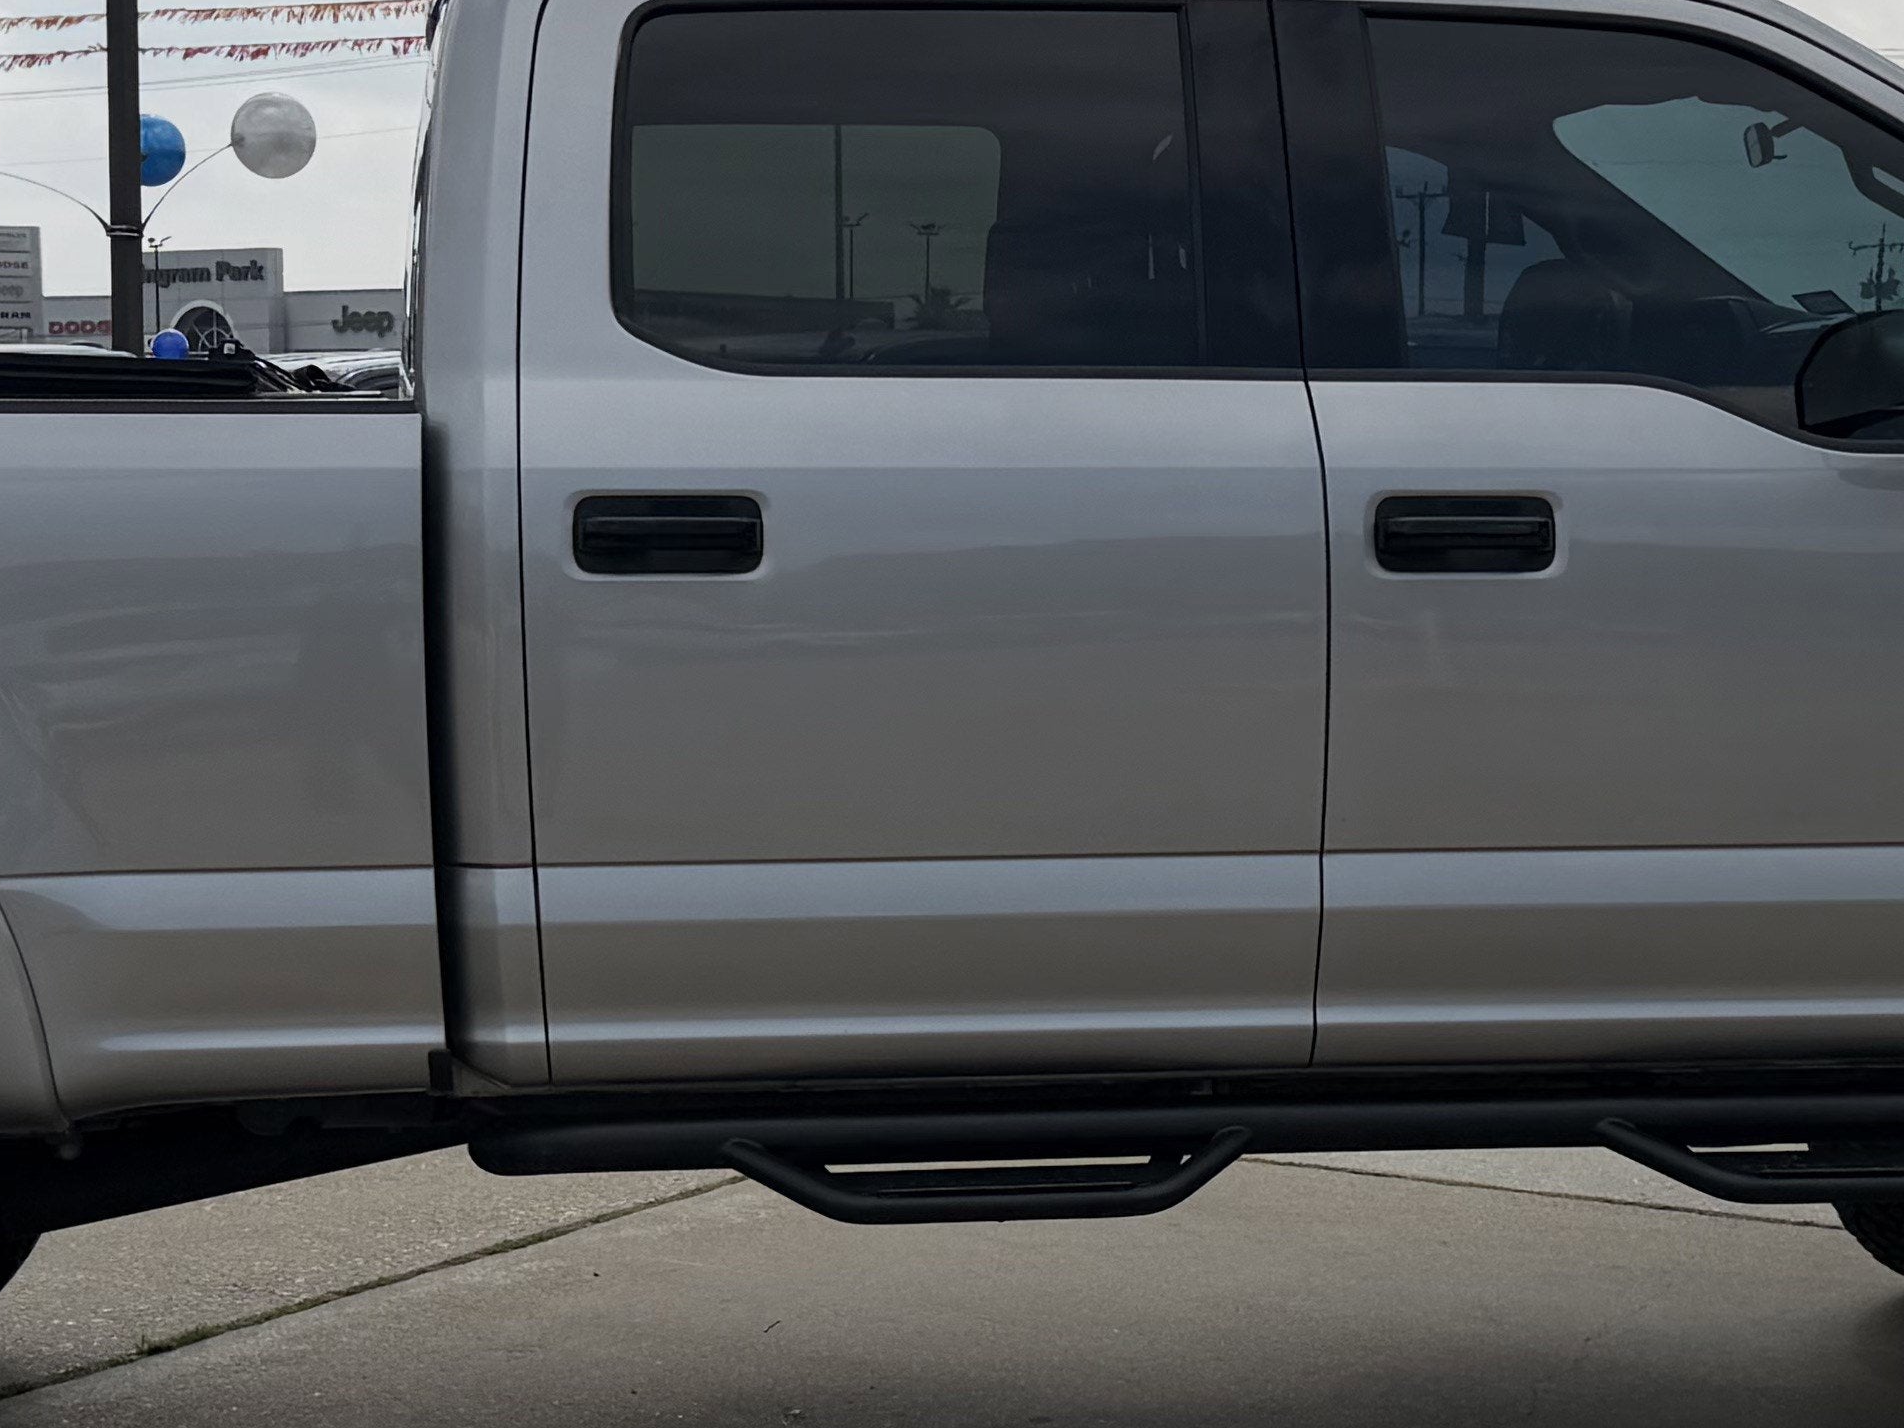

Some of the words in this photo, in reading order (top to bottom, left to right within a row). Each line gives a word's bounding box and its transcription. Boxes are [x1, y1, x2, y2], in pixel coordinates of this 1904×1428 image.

[143, 267, 211, 288] ngram
[215, 259, 264, 282] Park
[0, 311, 32, 320] RAM
[331, 304, 395, 338] Jeep
[47, 320, 112, 336] DODG
